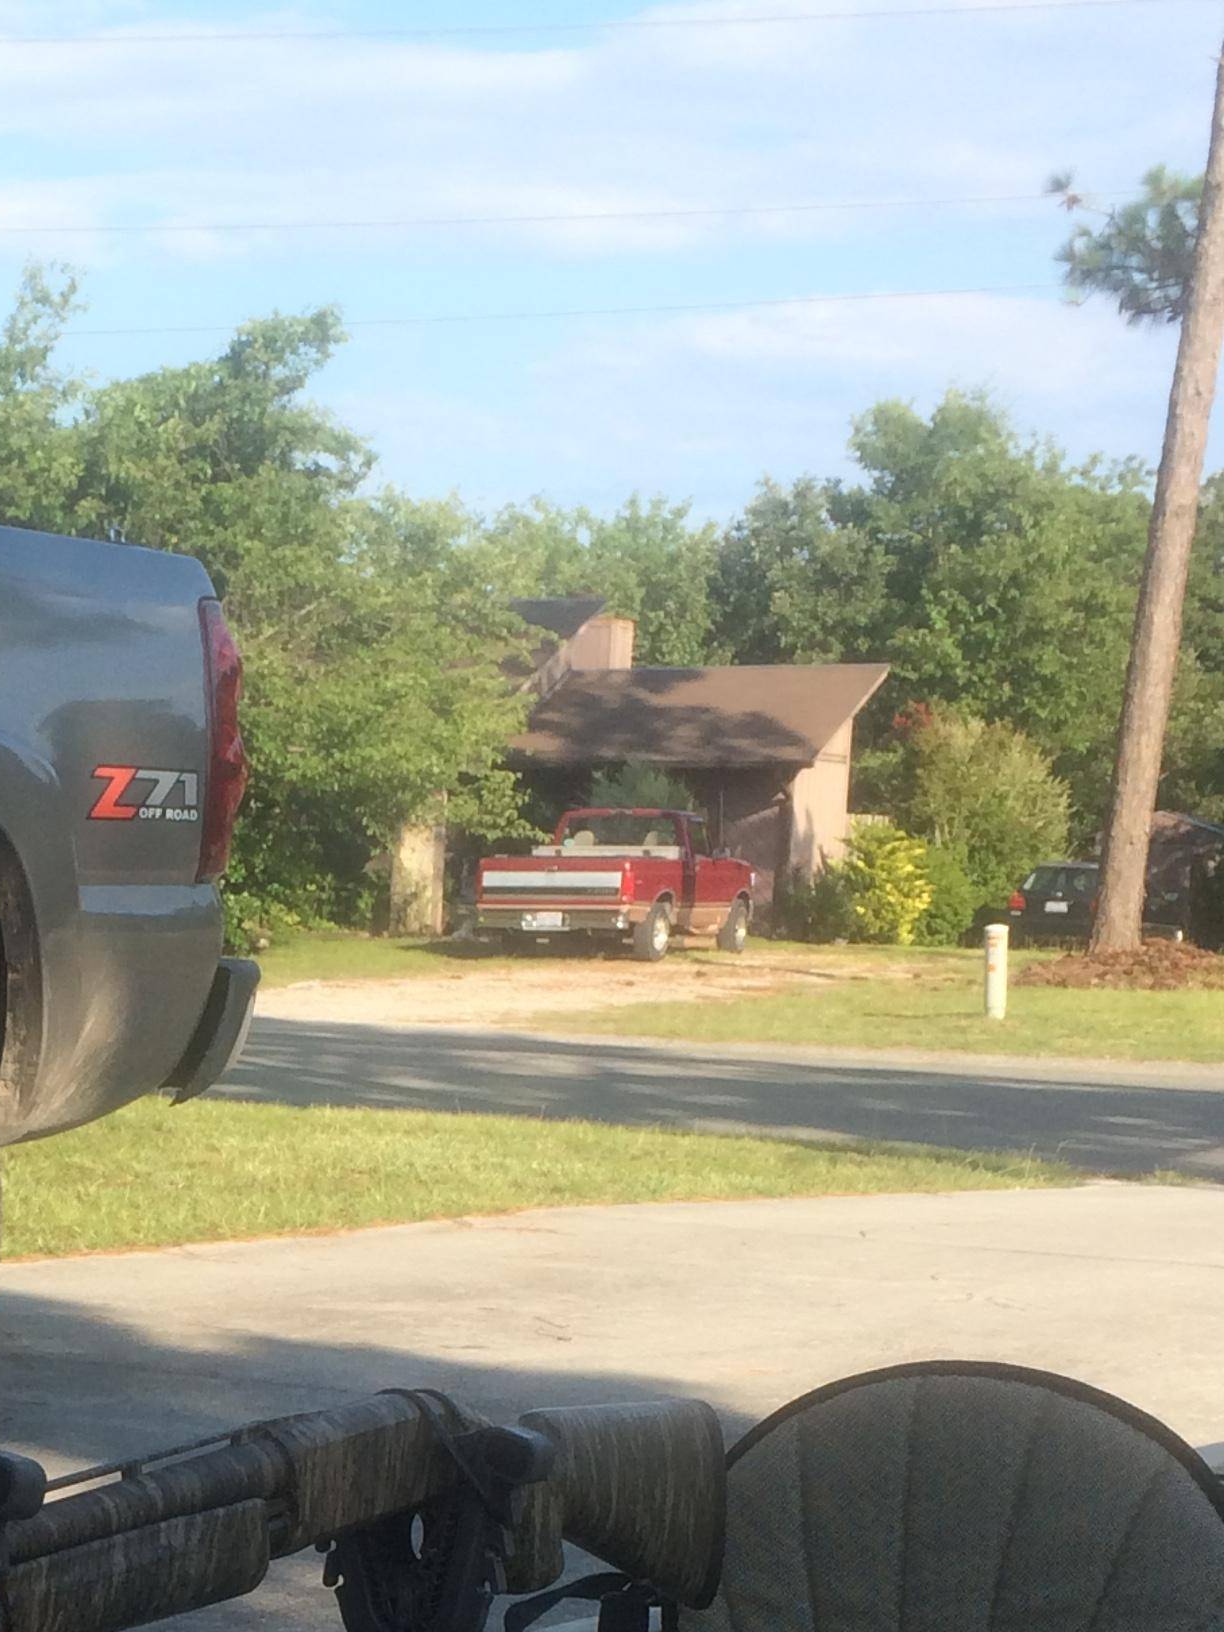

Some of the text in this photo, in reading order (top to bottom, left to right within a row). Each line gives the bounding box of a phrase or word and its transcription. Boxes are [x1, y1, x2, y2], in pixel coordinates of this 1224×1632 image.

[88, 765, 198, 820] Z71
[138, 806, 198, 821] OFF ROAD
